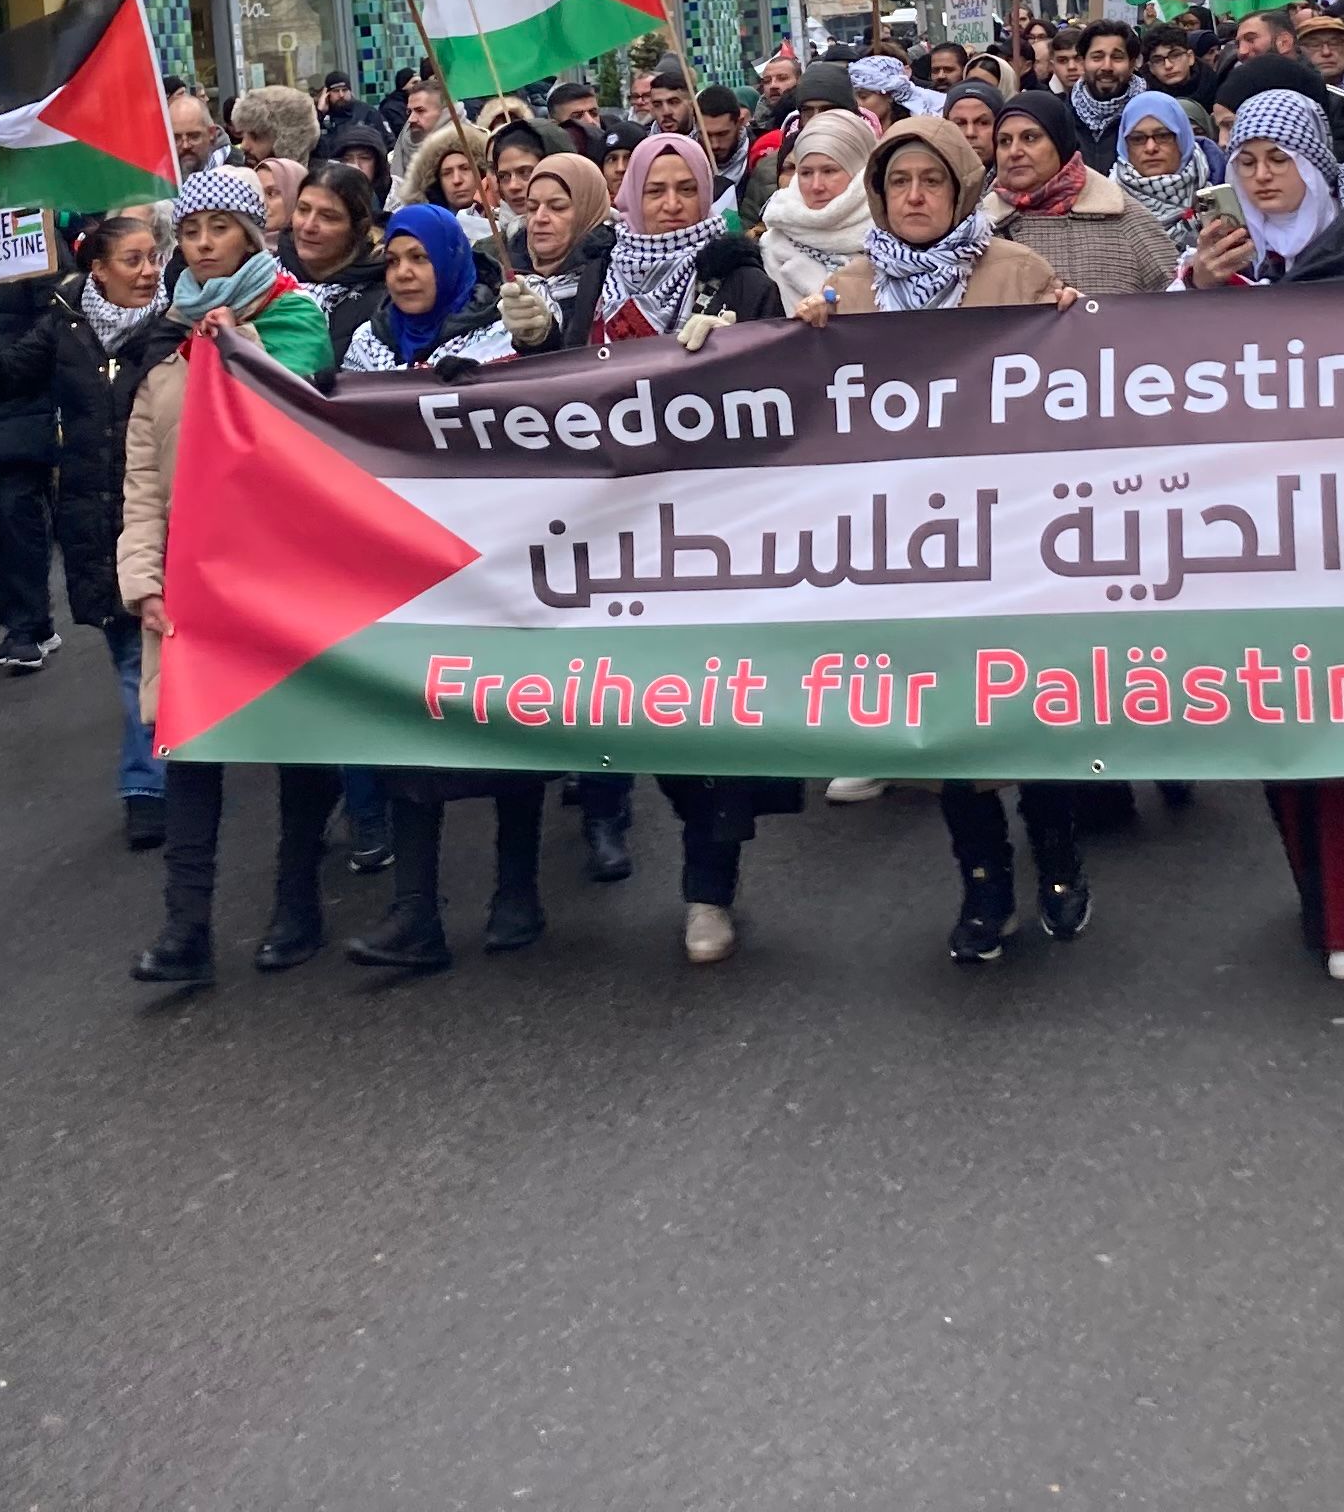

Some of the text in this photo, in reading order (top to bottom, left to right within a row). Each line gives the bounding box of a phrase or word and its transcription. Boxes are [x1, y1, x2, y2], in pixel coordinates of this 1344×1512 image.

[419, 378, 795, 450] Freedom
[826, 363, 957, 433] for
[528, 488, 999, 618] لفلسطين
[424, 653, 767, 727] Freiheit
[801, 652, 937, 727] für
